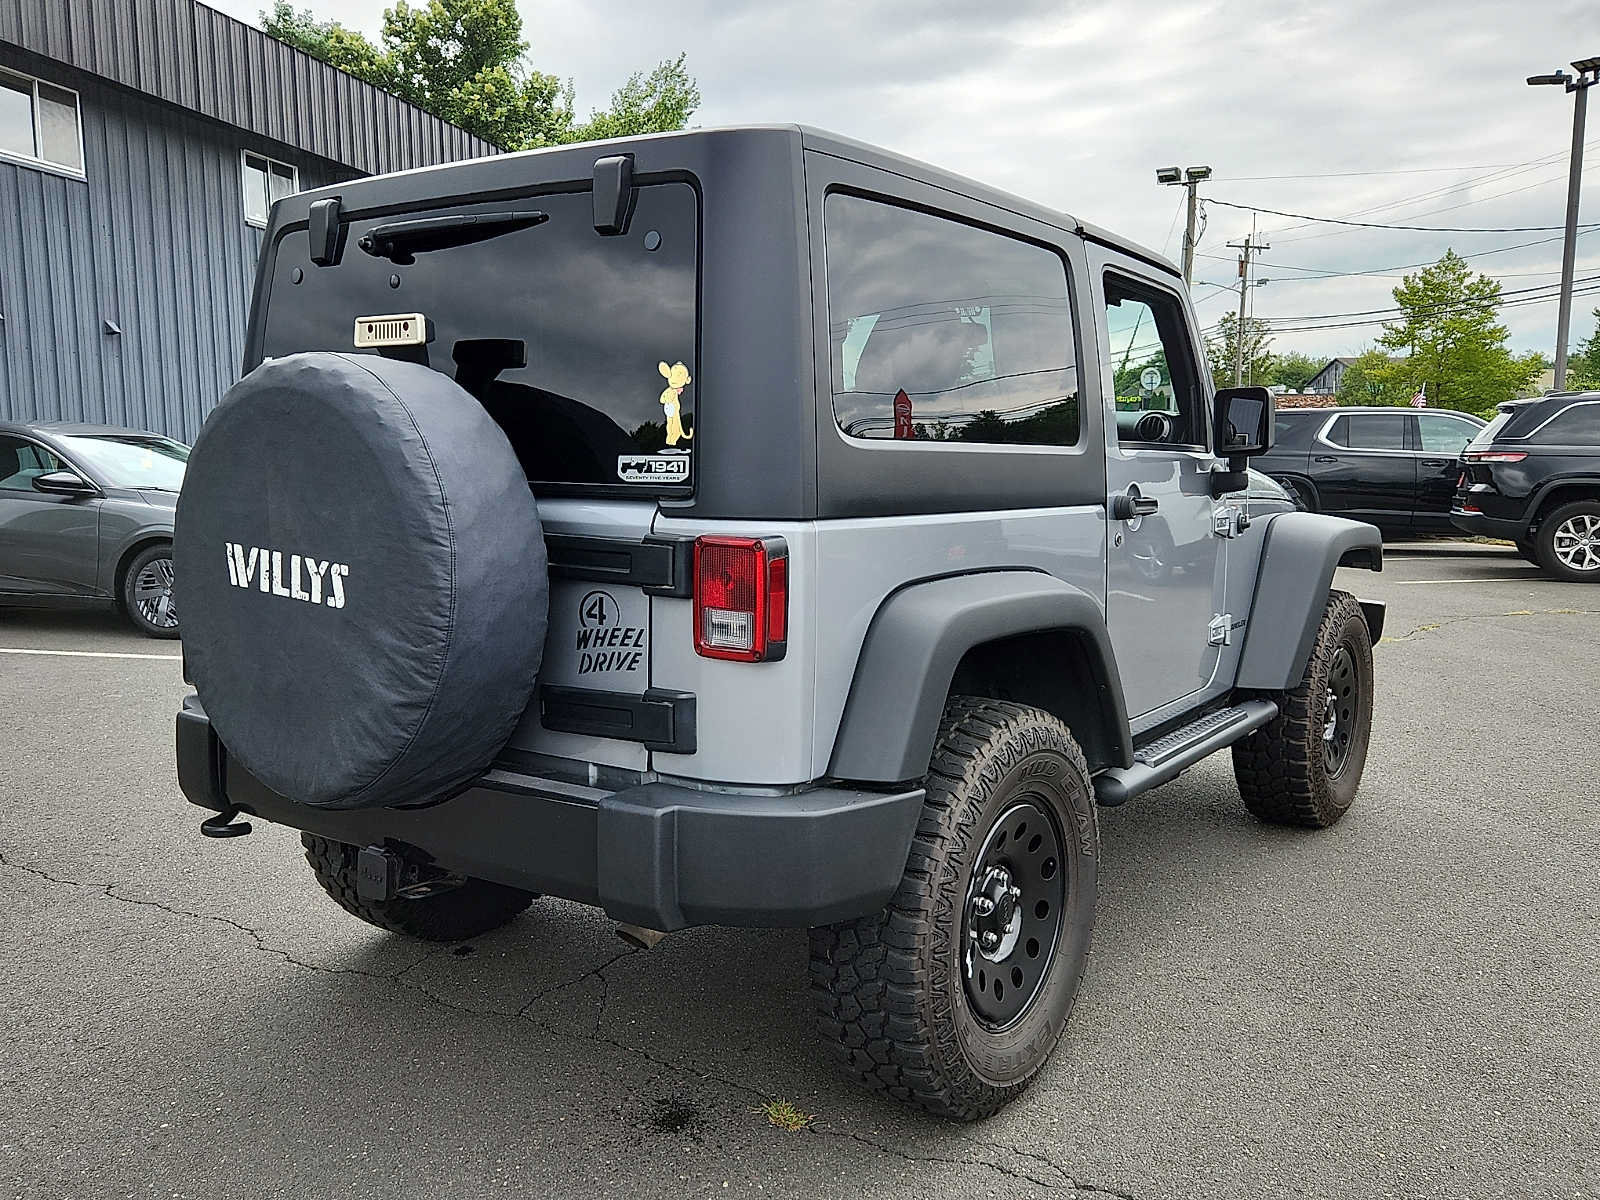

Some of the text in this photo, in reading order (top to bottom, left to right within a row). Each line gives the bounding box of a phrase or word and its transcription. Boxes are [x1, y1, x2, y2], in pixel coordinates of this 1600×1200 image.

[649, 461, 684, 473] 1941
[225, 542, 349, 609] WILLYS
[586, 596, 607, 626] 4
[576, 627, 645, 651] WHEEL
[578, 651, 643, 675] DRIVE
